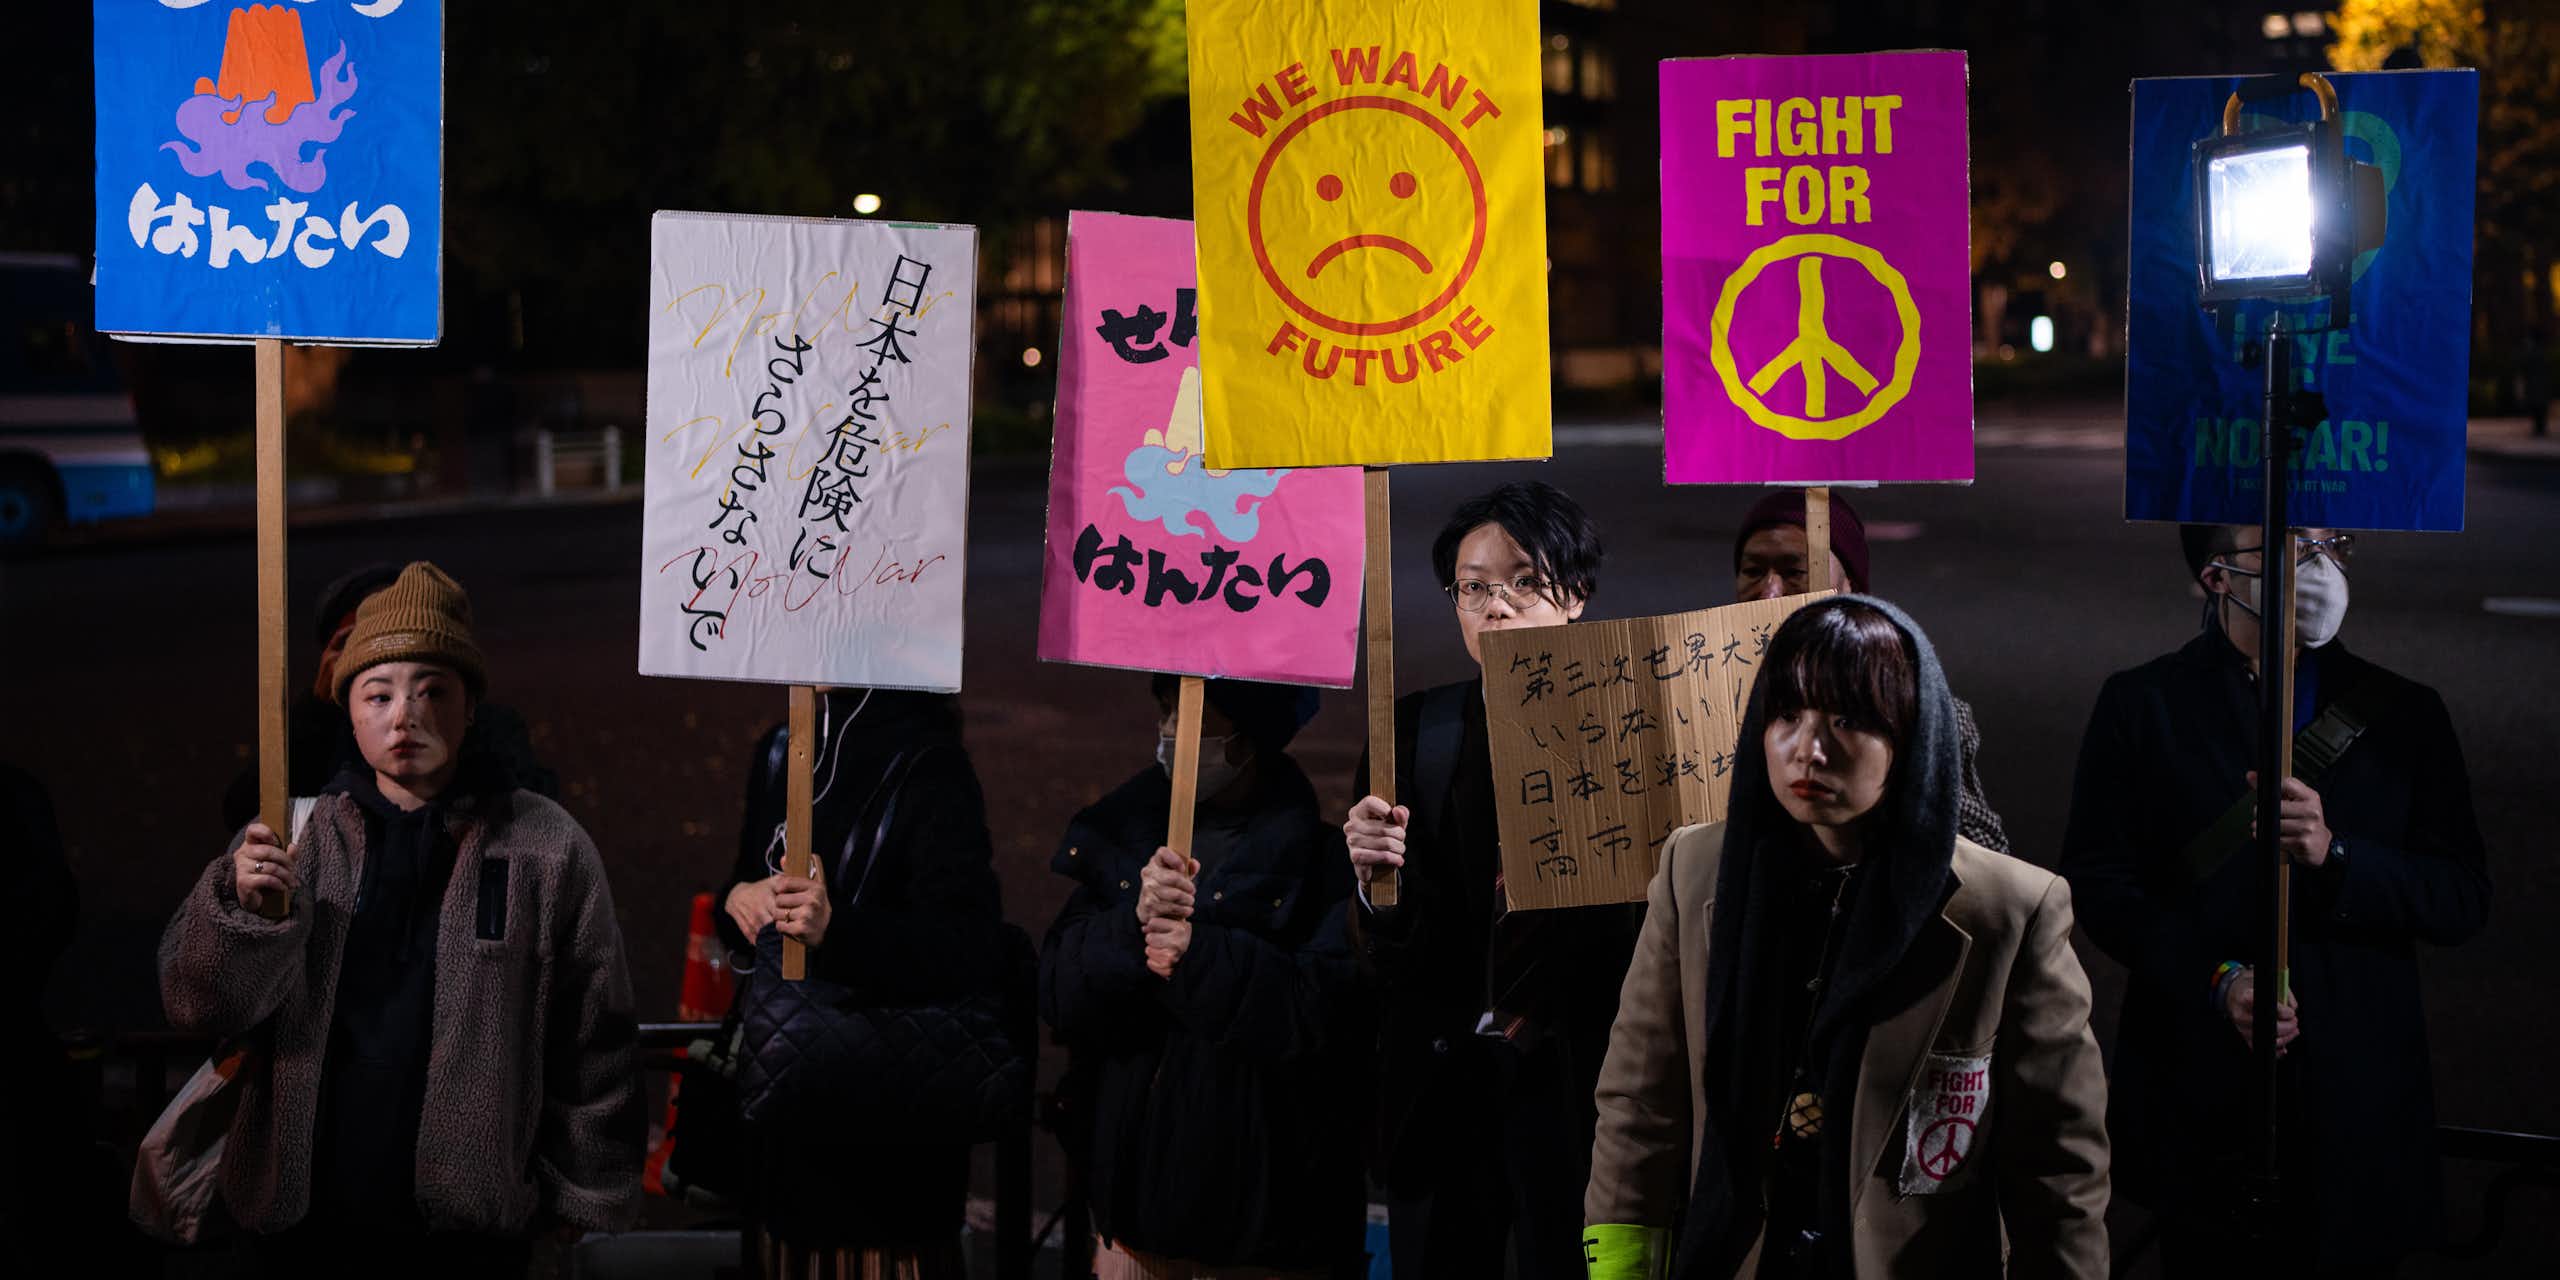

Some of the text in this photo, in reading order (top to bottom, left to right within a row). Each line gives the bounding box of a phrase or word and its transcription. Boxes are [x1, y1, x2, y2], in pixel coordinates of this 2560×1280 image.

[1229, 46, 1501, 138] WE WANT
[1716, 95, 1902, 158] FIGHT
[128, 182, 410, 268] はんたい
[1744, 165, 1872, 226] FOR
[1266, 305, 1495, 386] FUTURE
[788, 254, 932, 580] 日本を危険に
[2195, 417, 2390, 472] NO AR!
[680, 333, 813, 651] さらさないで
[660, 535, 946, 640] No War
[1073, 523, 1331, 613] はんたい
[1928, 1069, 1985, 1093] FIGHT
[1935, 1094, 1976, 1115] FOR
